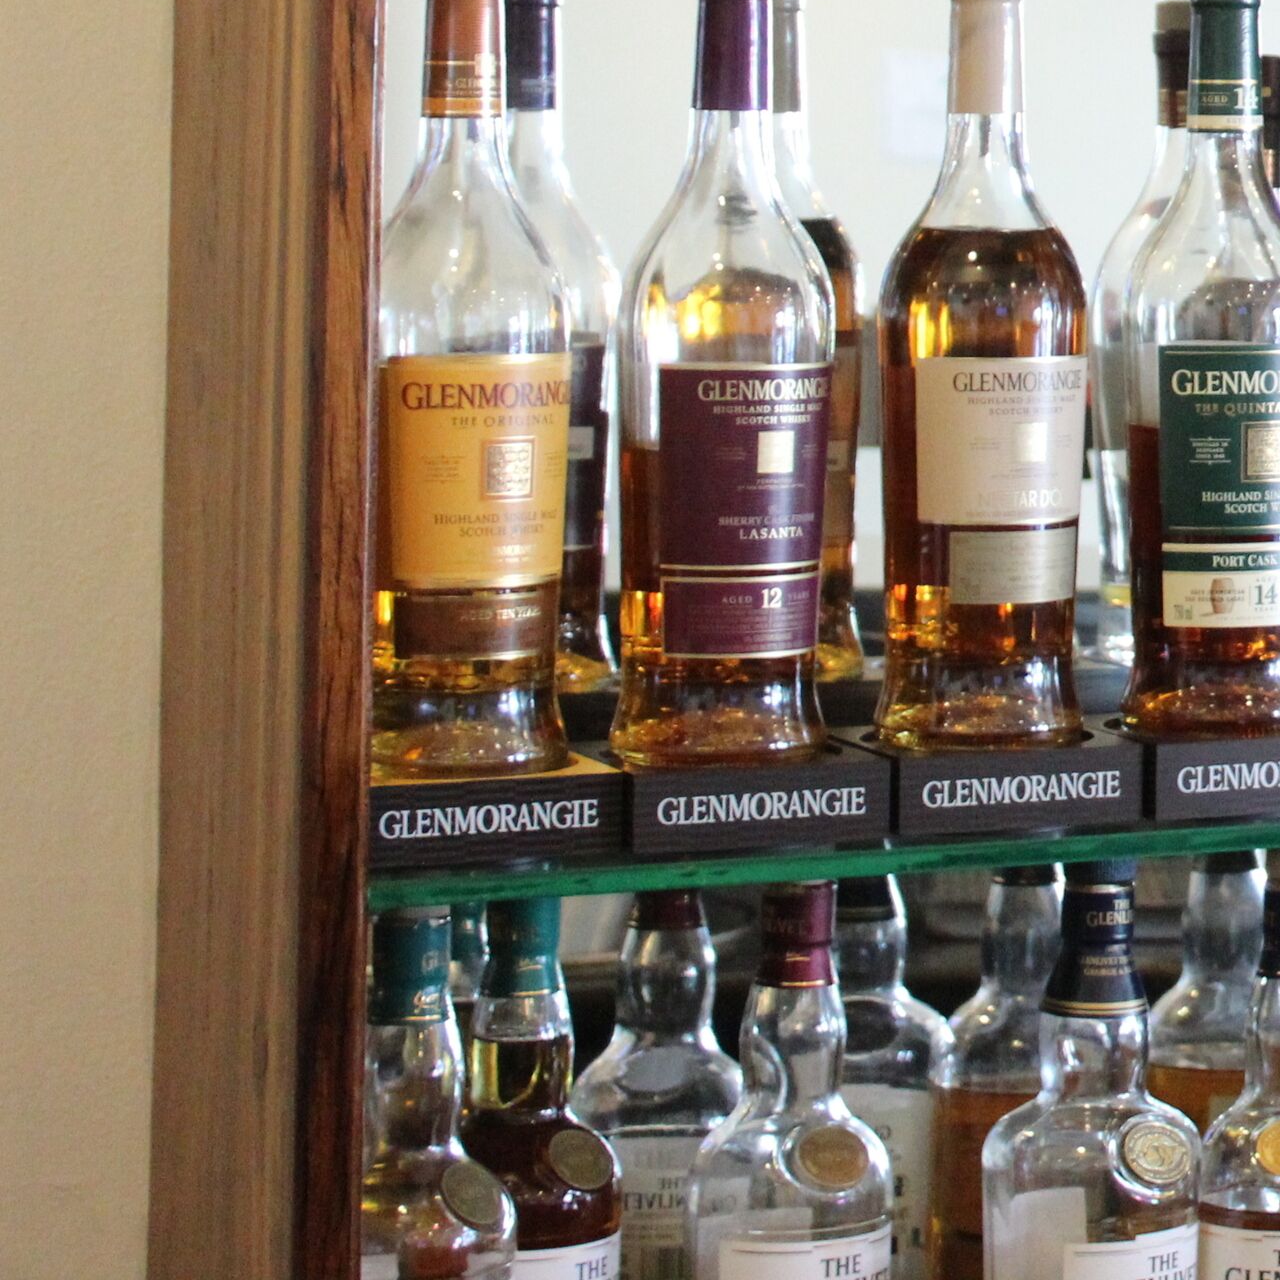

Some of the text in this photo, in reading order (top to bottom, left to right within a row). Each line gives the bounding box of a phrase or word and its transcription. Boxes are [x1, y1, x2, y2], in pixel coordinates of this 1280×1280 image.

[1234, 85, 1259, 109] 14
[953, 369, 1082, 393] GLENMORANGIE
[968, 397, 1023, 405] HIGHLAND
[1195, 403, 1219, 413] THE
[713, 404, 804, 414] HIGHLAND SINGLE
[989, 408, 1029, 416] SCOTCH
[452, 413, 554, 429] THE ORIGINAL
[736, 416, 777, 425] SCOTCH
[1202, 491, 1261, 502] HIGHLAND
[1224, 503, 1267, 514] SCOTCH
[434, 514, 499, 525] HIGHLAND
[459, 526, 505, 537] SCOTCH
[739, 527, 804, 540] LASANTA
[1212, 556, 1245, 567] PORT
[1248, 554, 1278, 565] CASK
[721, 596, 752, 604] AGED
[761, 588, 783, 608] 12
[1255, 584, 1277, 605] 14
[921, 769, 1121, 809] GLENMORANGIE
[657, 785, 867, 827] GLENMORANGIE
[379, 798, 600, 841] GLENMORANGIE
[575, 1255, 608, 1280] THE
[821, 1253, 861, 1278] THE
[1148, 1251, 1179, 1272] THE
